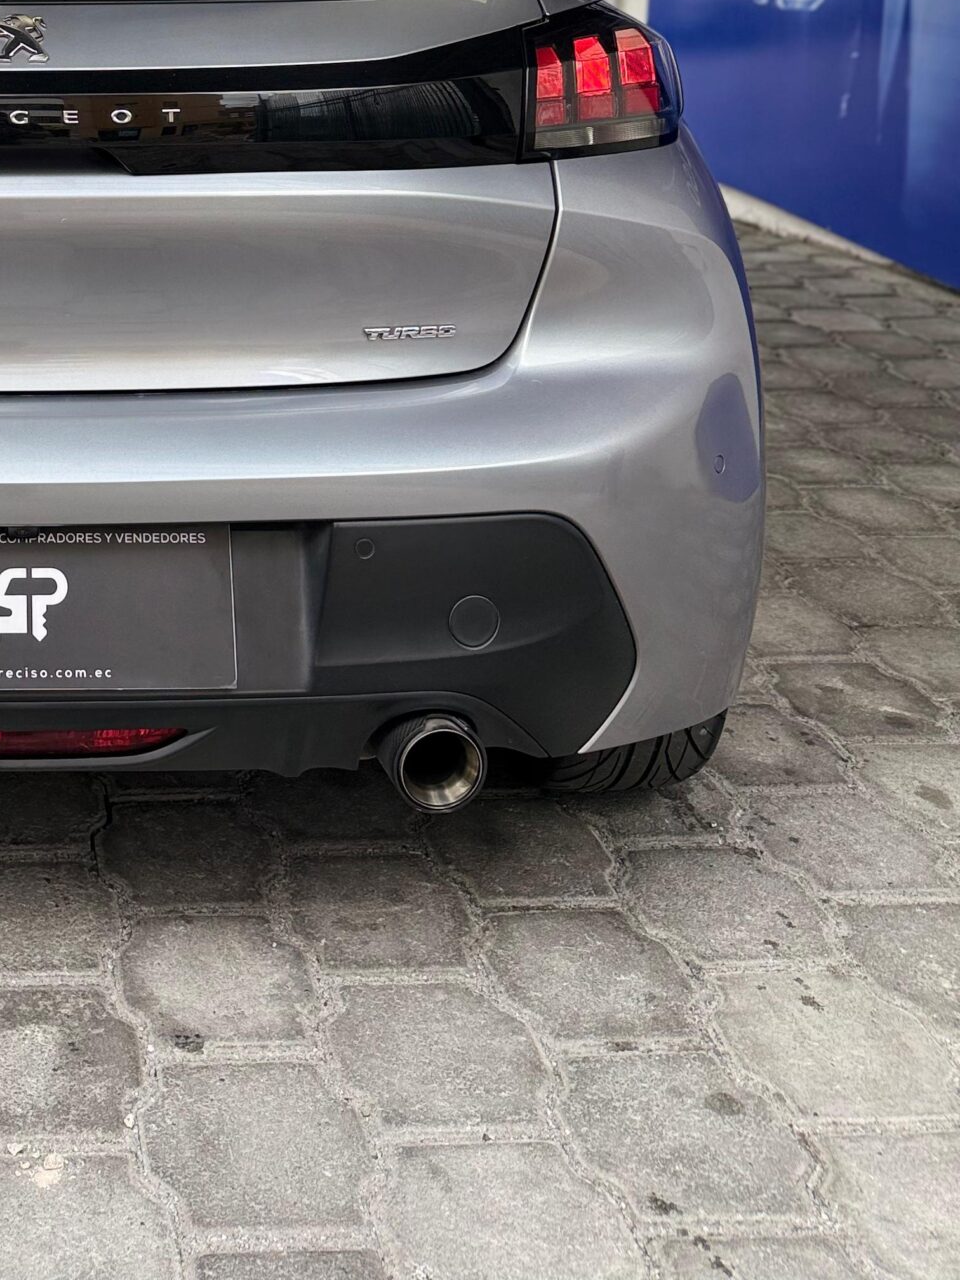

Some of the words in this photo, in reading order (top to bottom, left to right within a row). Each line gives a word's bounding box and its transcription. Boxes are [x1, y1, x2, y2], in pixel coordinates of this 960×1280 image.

[363, 324, 457, 341] TURBO
[104, 532, 114, 544] Y
[115, 532, 206, 544] VENDEDORES
